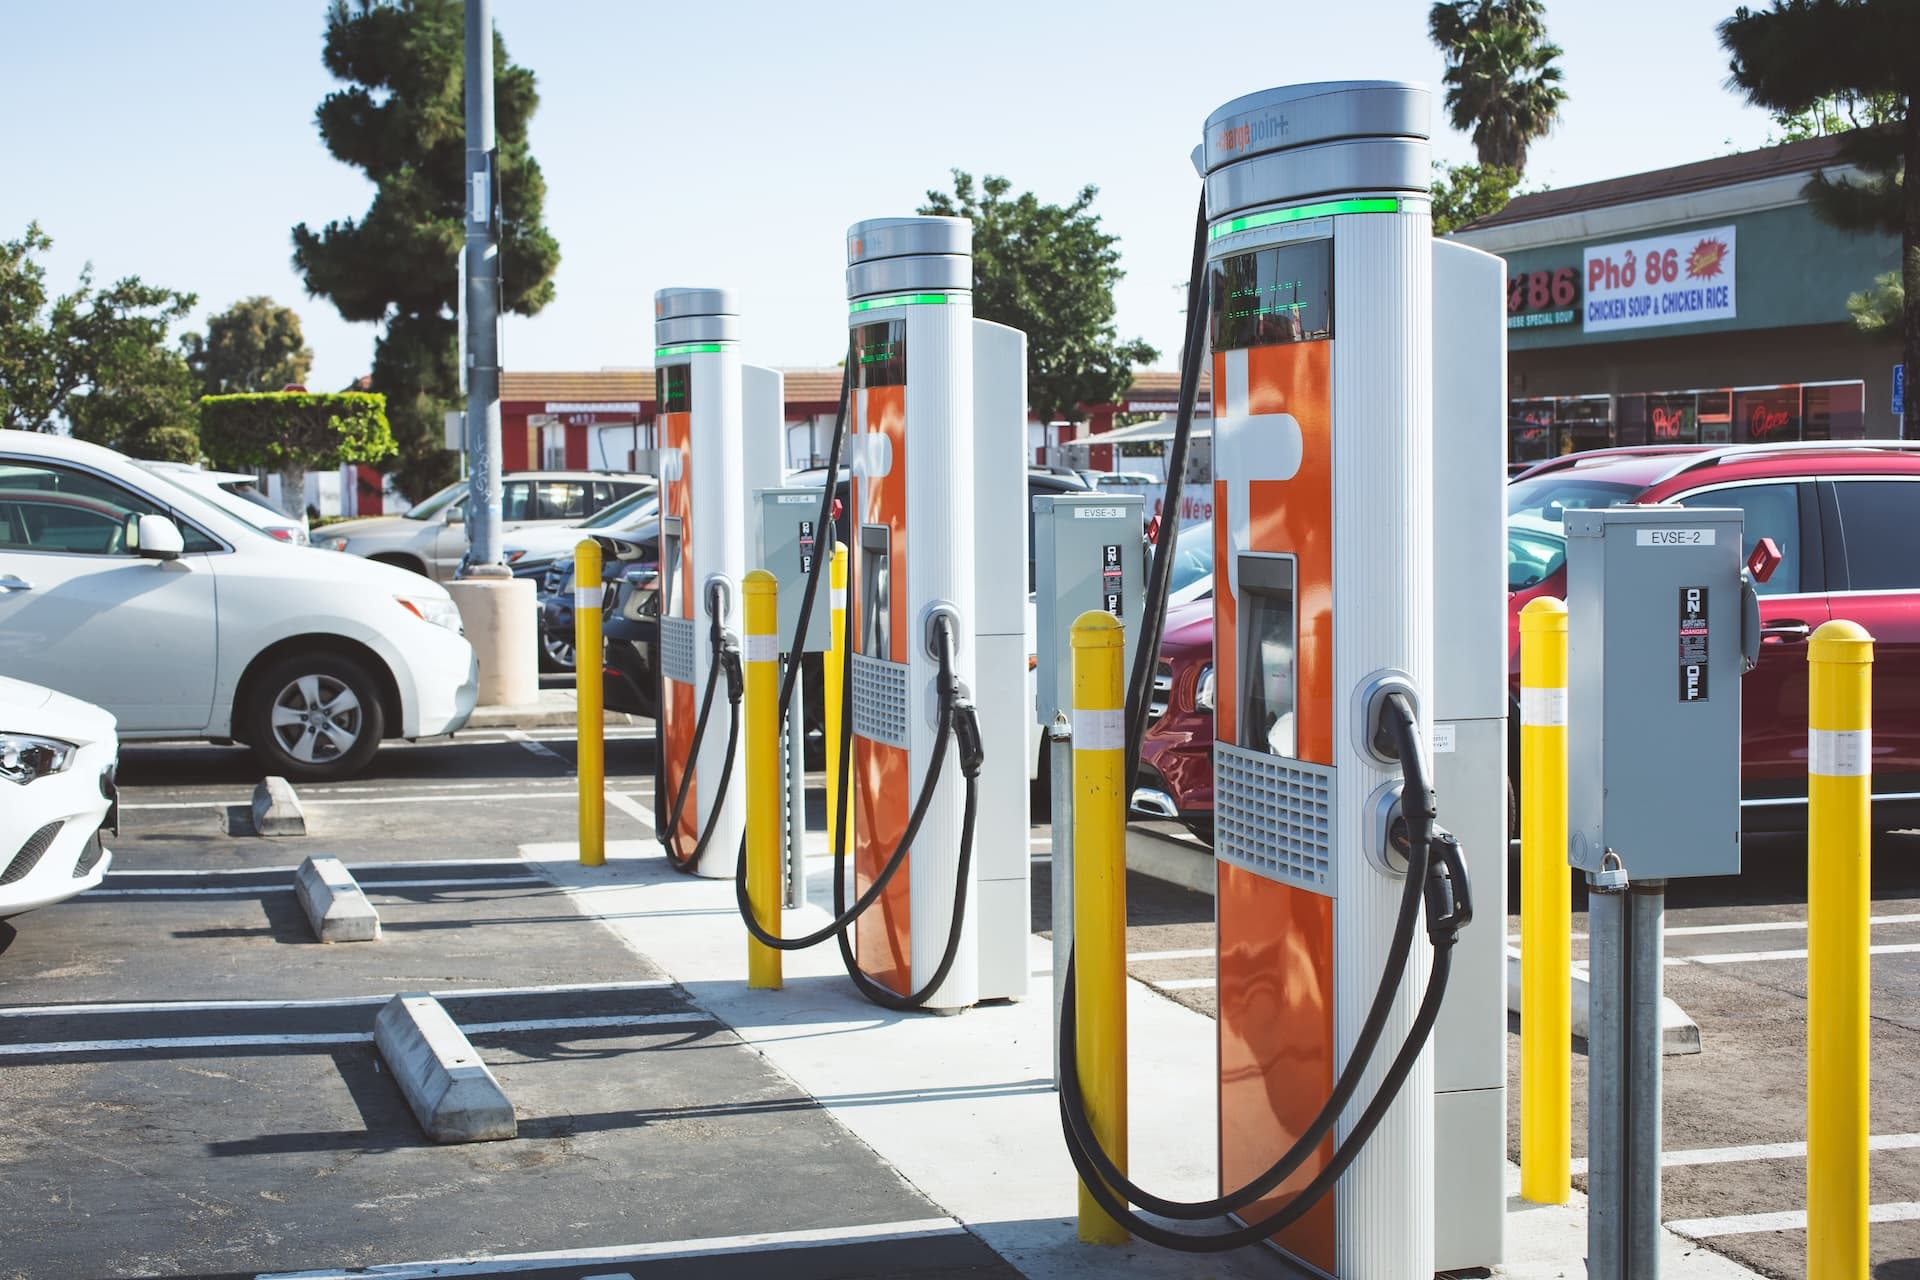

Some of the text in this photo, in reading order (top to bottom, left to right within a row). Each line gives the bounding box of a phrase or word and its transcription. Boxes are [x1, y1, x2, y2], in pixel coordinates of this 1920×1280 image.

[1645, 248, 1678, 285] 86
[1527, 266, 1575, 309] 86
[1588, 285, 1729, 322] CHICKEN SOUP & CHICKEN RICE
[1084, 508, 1117, 517] EVSE-3
[1651, 531, 1701, 544] EVSE-2
[1107, 546, 1117, 562] ON
[1687, 588, 1701, 613] ON
[1686, 665, 1700, 700] OFF
